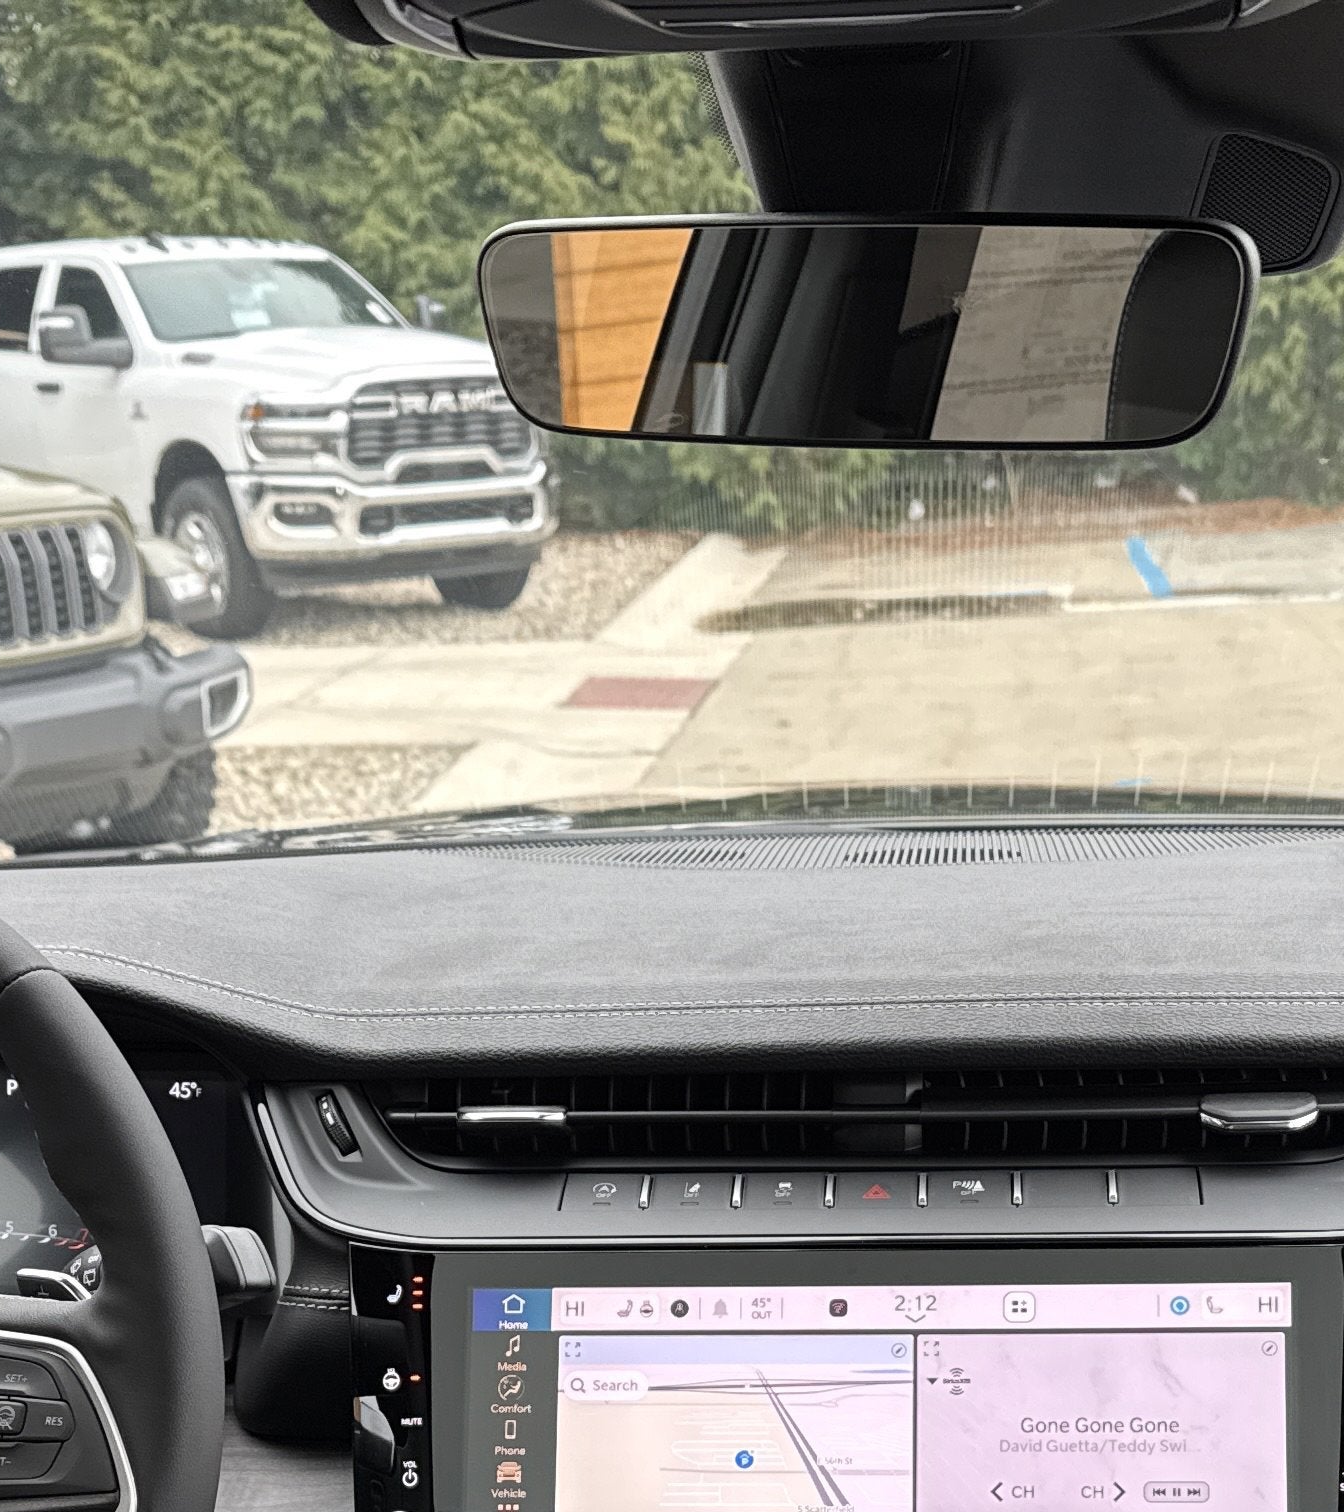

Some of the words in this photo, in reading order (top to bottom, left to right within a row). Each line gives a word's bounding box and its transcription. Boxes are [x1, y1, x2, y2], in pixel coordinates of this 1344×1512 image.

[6, 1079, 18, 1096] P
[6, 1221, 14, 1233] 5
[48, 1224, 58, 1237] 6
[751, 1297, 771, 1308] 45°
[894, 1295, 937, 1312] 2:12
[1258, 1296, 1278, 1313] HI
[565, 1301, 585, 1317] HI
[751, 1311, 772, 1320] OUT
[499, 1320, 528, 1330] Home
[497, 1362, 527, 1372] Media
[592, 1379, 638, 1391] Search
[490, 1404, 532, 1414] Comfort
[45, 1416, 64, 1426] RES
[401, 1417, 423, 1426] MUTE
[1020, 1416, 1070, 1433] Gone
[1074, 1416, 1125, 1433] Gone
[1129, 1416, 1180, 1433] Gone
[494, 1446, 526, 1455] Phone
[999, 1439, 1042, 1453] David
[1046, 1439, 1155, 1455] Guetta/Teddy
[490, 1488, 527, 1499] Vehicle
[1011, 1486, 1035, 1499] CH
[1081, 1486, 1105, 1499] CH
